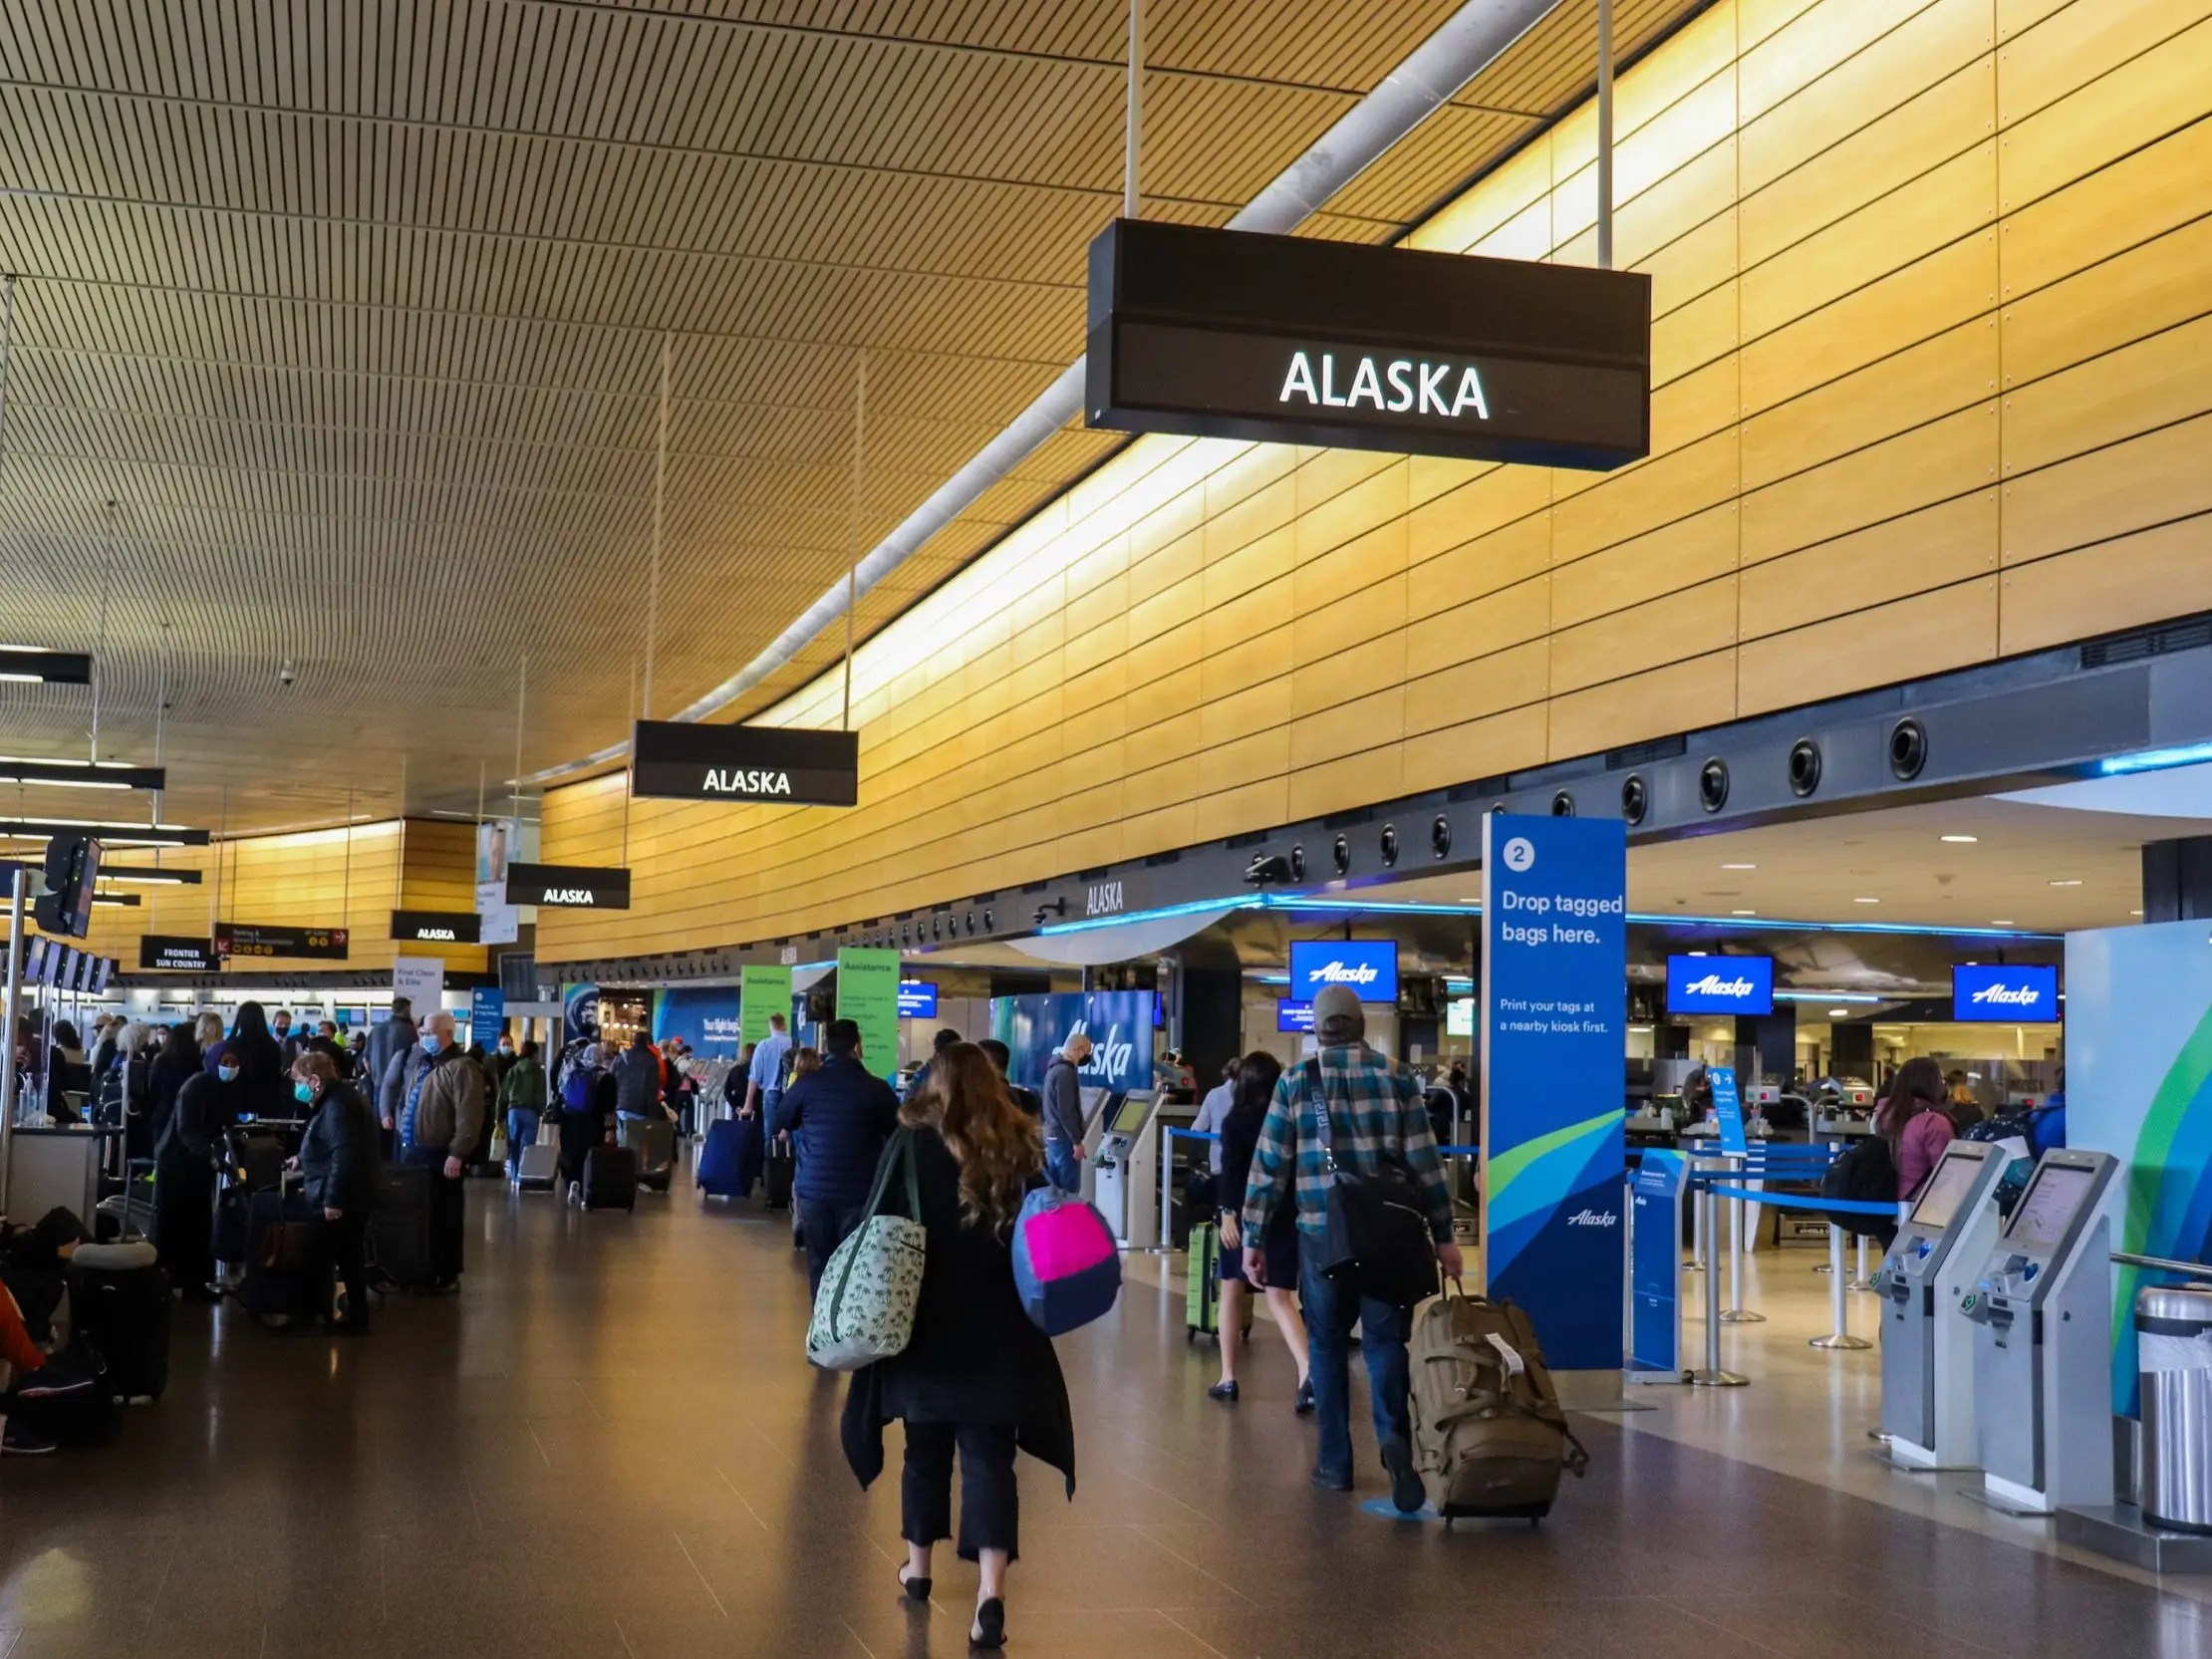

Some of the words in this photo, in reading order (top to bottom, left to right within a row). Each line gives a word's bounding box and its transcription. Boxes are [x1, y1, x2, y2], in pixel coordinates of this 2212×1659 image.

[1279, 352, 1489, 419] ALASKA
[702, 768, 791, 795] ALASKA
[1514, 845, 1524, 862] 2
[543, 888, 594, 905] ALASKA
[1086, 881, 1123, 916] ALASKA
[1503, 890, 1550, 915] Drop
[1554, 894, 1623, 917] tagged
[417, 929, 455, 941] ALASKA
[1502, 922, 1547, 947] bags
[1552, 923, 1600, 944] here.
[163, 948, 200, 959] FRONTIER
[155, 959, 171, 968] SUN
[172, 960, 206, 969] COUNTRY
[844, 963, 892, 972] Assistance
[1309, 961, 1378, 984] Alaska
[1685, 974, 1754, 997] Alaska
[1972, 983, 2040, 1005] Alaska
[1500, 998, 1527, 1010] Print
[1529, 1001, 1554, 1013] your
[1557, 1000, 1580, 1014] tags
[1583, 1001, 1594, 1012] at
[1500, 1021, 1507, 1030] a
[1510, 1019, 1548, 1034] nearby
[1551, 1020, 1580, 1032] kiosk
[1582, 1020, 1608, 1033] first.
[1567, 1209, 1617, 1227] Alaska
